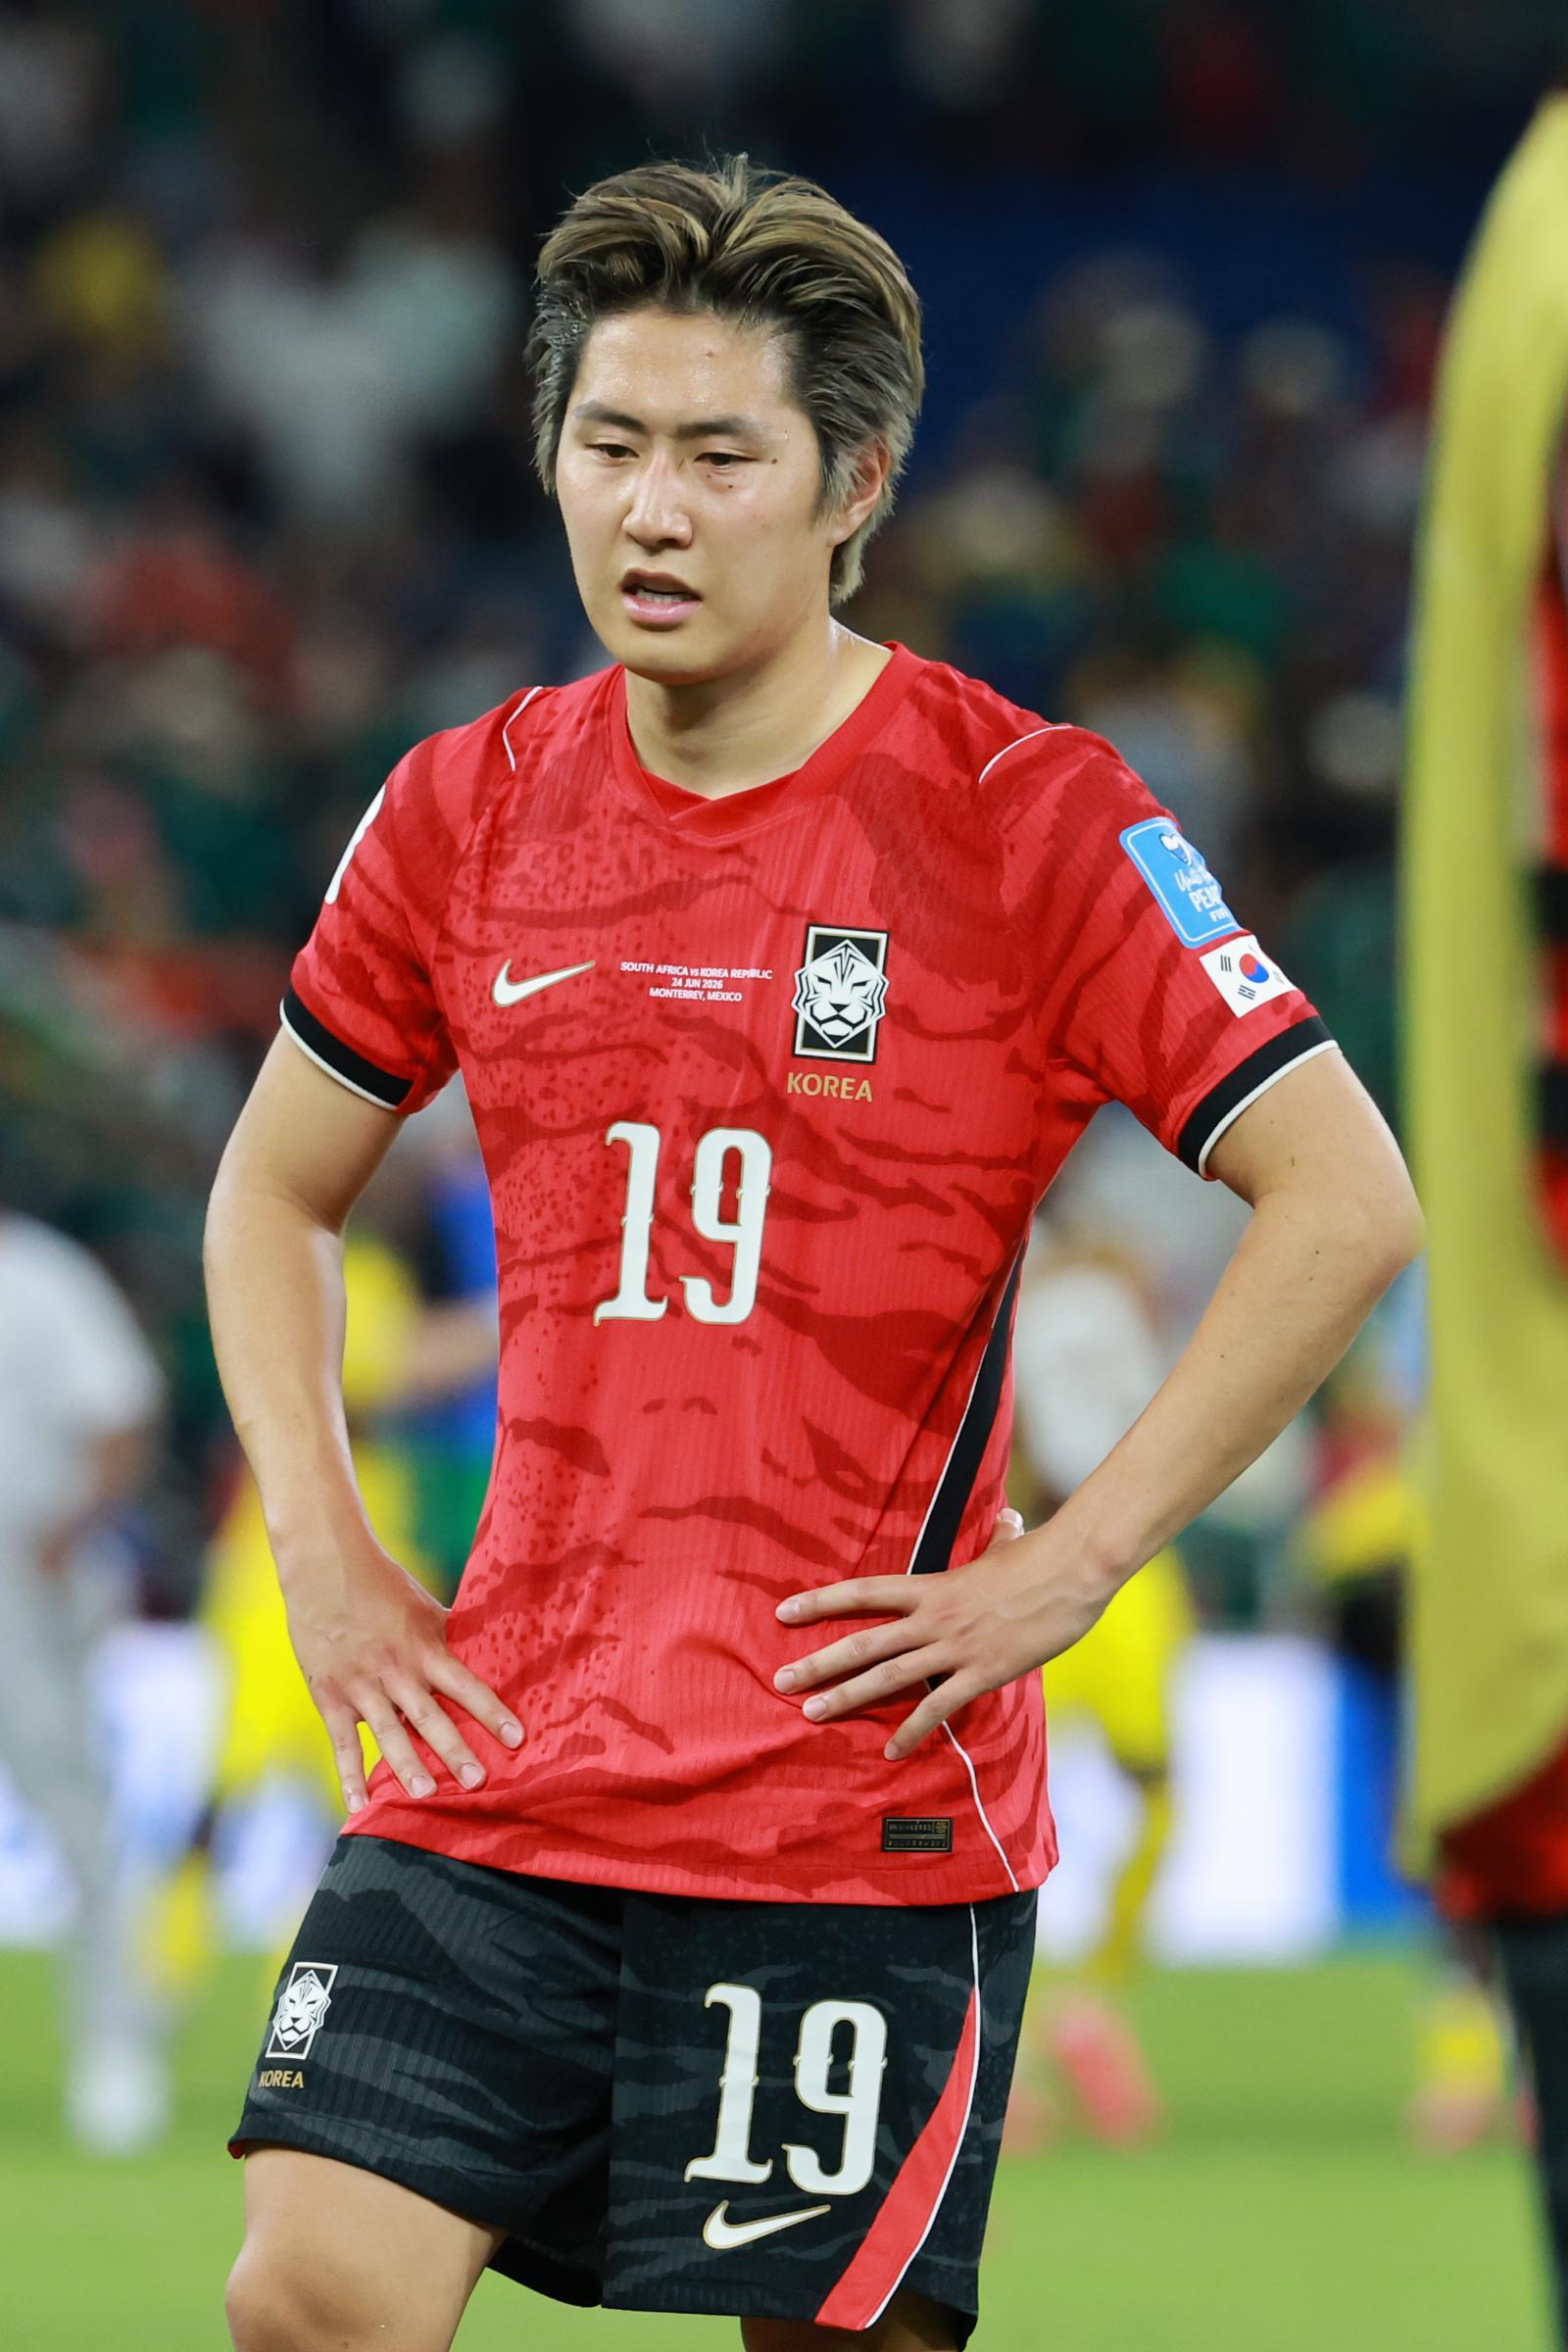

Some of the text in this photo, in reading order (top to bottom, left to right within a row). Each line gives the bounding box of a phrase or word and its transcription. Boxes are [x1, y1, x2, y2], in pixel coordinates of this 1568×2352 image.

[620, 961, 655, 973] SOUTH
[656, 964, 688, 976] AFRICA
[700, 967, 728, 978] KOREA
[730, 968, 773, 979] REPUBLIC
[671, 977, 723, 989] 24 JUN 2026
[649, 987, 743, 1003] MONTERREY, MEXICO
[787, 1072, 873, 1102] KOREA
[594, 1120, 773, 1325] 19
[258, 2070, 305, 2088] KOREA
[684, 1982, 889, 2196] 19
